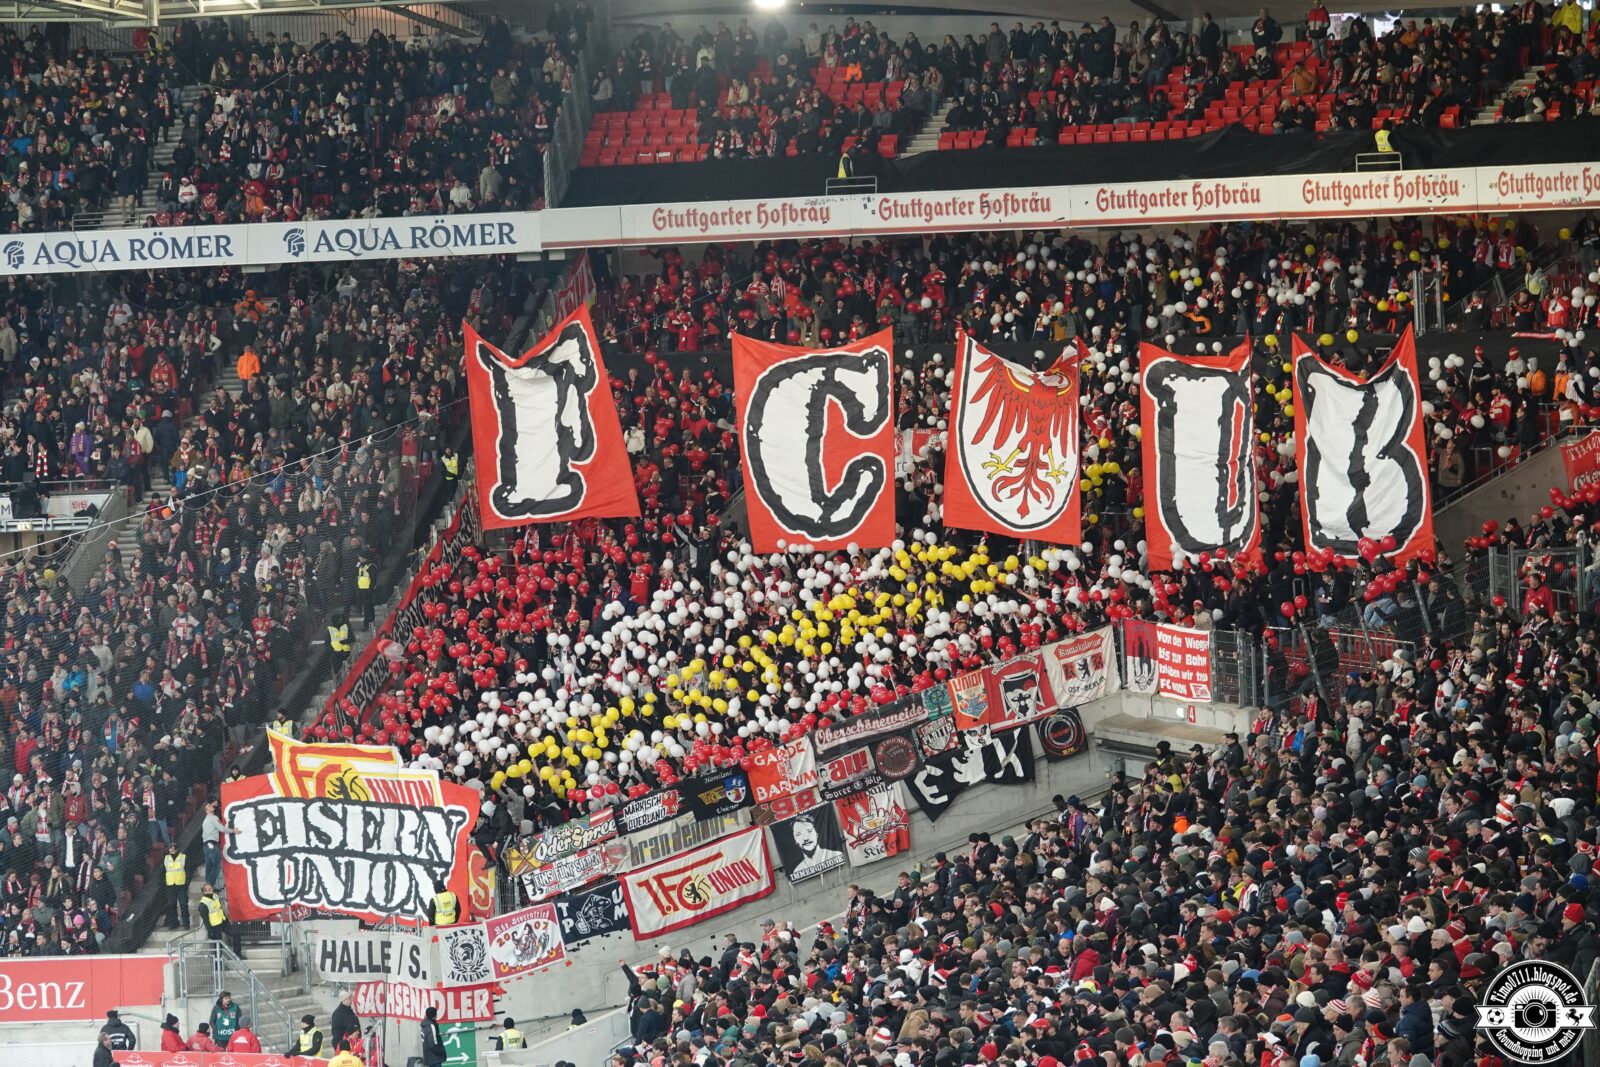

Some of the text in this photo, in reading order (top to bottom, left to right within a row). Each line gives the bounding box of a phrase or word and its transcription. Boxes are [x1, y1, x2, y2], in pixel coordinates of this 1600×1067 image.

[1096, 181, 1261, 214] Stuttgarter Hofbräu
[1302, 173, 1459, 207] Stuttgarter Hofbräu
[1498, 171, 1579, 200] Stuttgarter
[653, 207, 752, 232] Stuttgarter
[878, 191, 1051, 223] Stuttgarter Hofbräu
[32, 231, 234, 268] AQUA RÖMER
[313, 219, 517, 257] AQUA RÖMER
[744, 345, 891, 541] C
[1294, 352, 1426, 560] B
[754, 740, 806, 767] GARDE
[756, 769, 819, 801] BARNIM
[230, 800, 466, 864] EISERN
[535, 820, 617, 861] Oder Spree
[250, 853, 449, 920] UNION
[707, 858, 761, 895] UNION
[444, 928, 485, 942] SIXTY
[320, 939, 392, 974] HALLE
[0, 973, 86, 1011] Benz
[447, 967, 490, 983] NINERS
[357, 982, 491, 1020] SACHSENADLER
